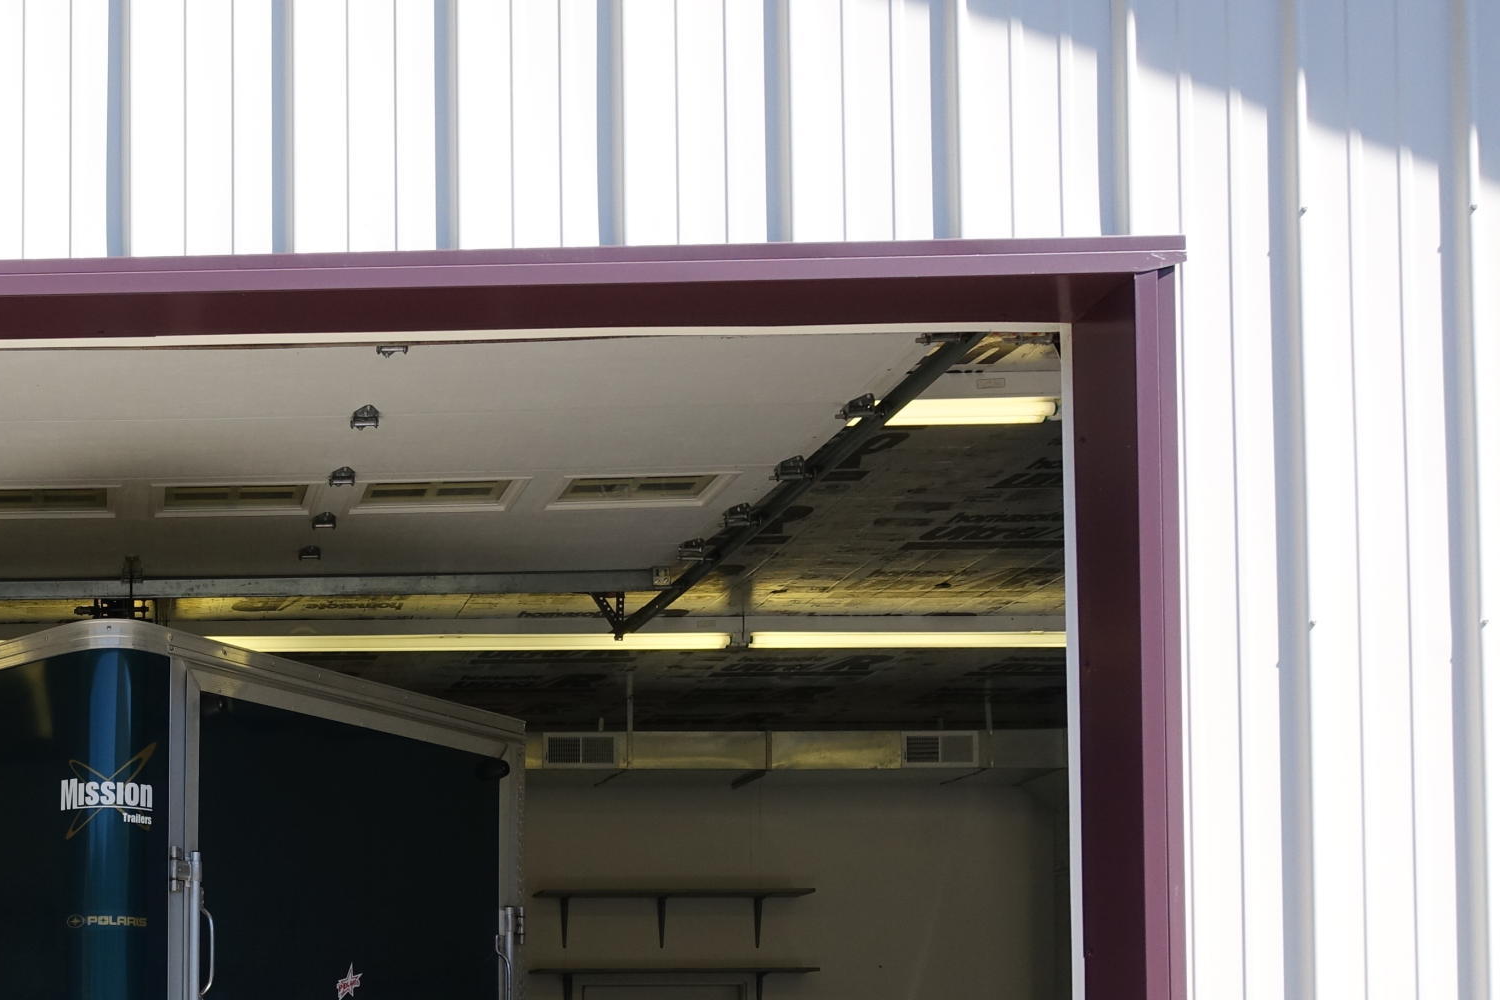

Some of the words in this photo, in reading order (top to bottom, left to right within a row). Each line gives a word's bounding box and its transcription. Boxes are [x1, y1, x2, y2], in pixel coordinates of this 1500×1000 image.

[60, 778, 153, 811] Mission
[122, 812, 153, 825] Trailers
[86, 915, 148, 928] POLARIS
